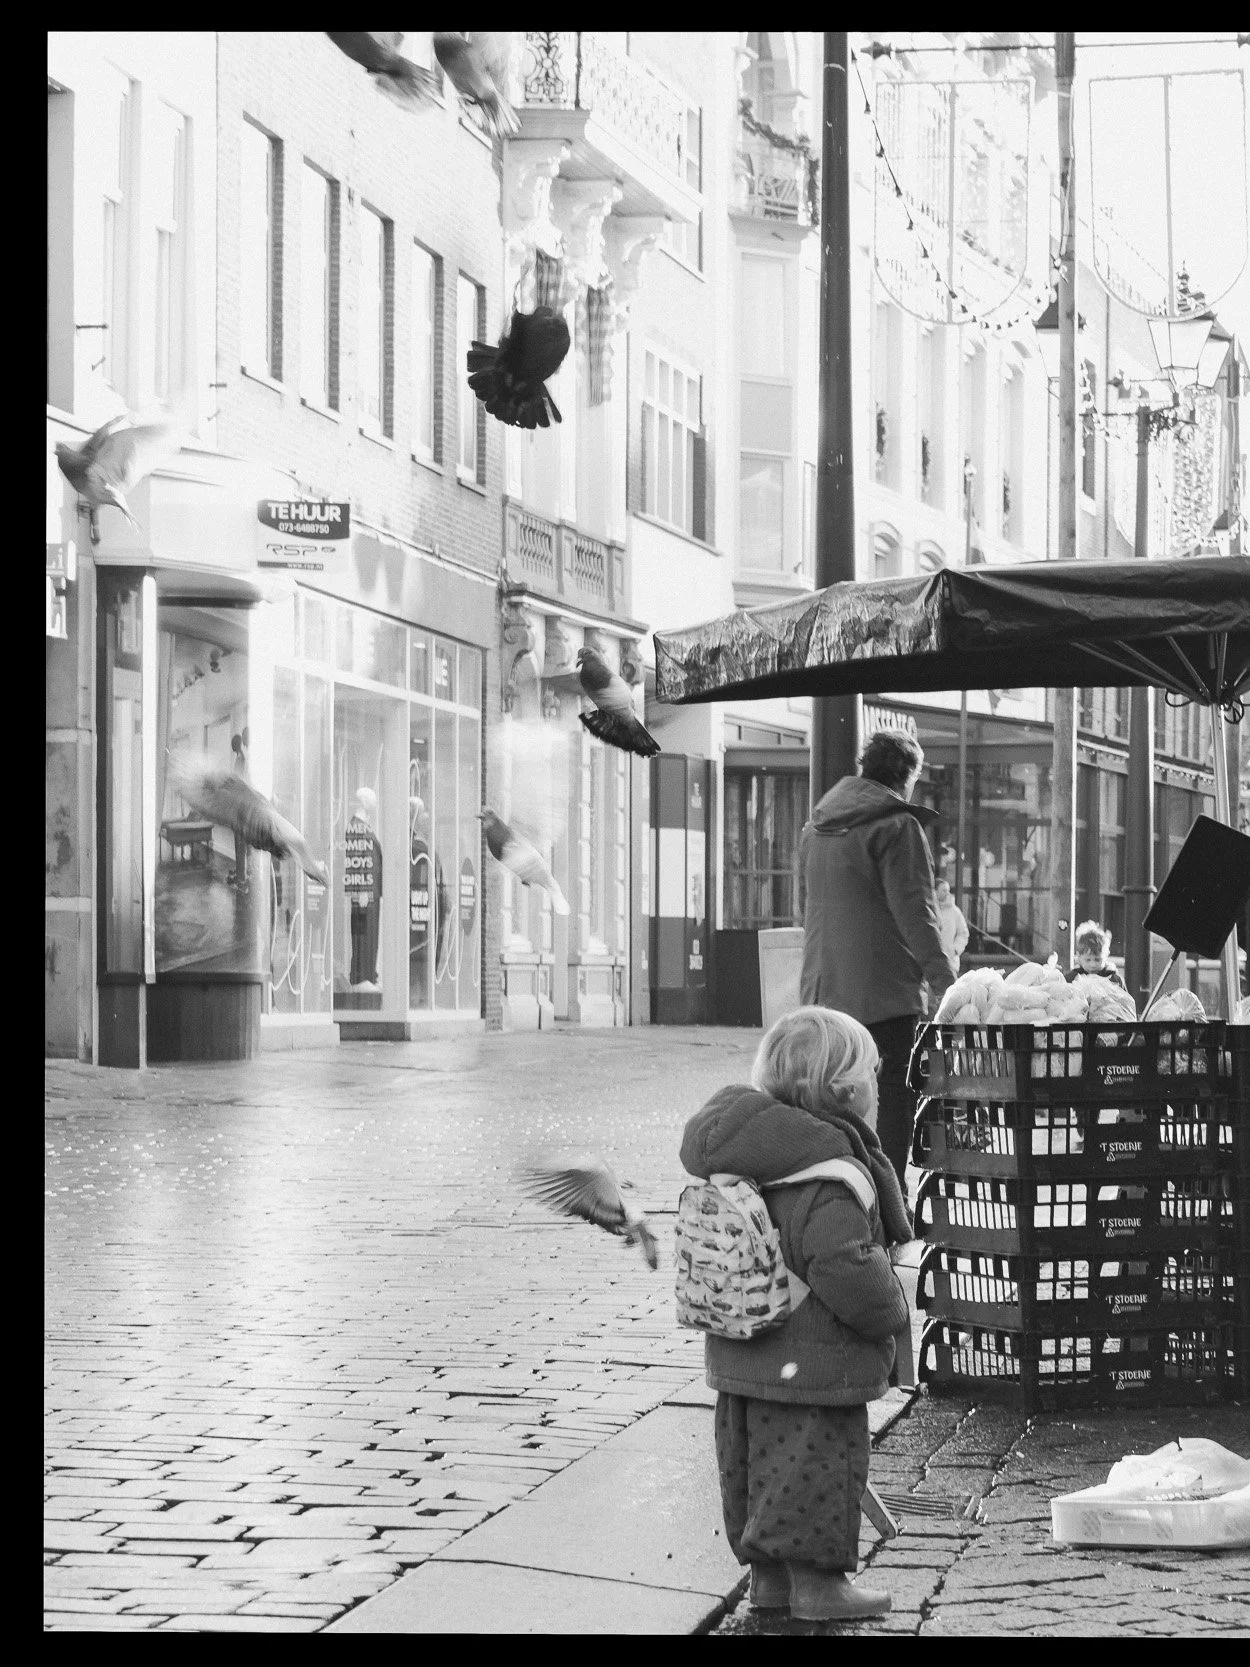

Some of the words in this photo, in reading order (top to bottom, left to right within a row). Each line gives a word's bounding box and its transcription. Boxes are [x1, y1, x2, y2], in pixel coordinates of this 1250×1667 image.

[267, 503, 289, 519] TE
[290, 503, 342, 522] HUUR
[347, 822, 375, 834] MEN
[345, 856, 374, 868] BOYS
[343, 874, 374, 885] GIRLS
